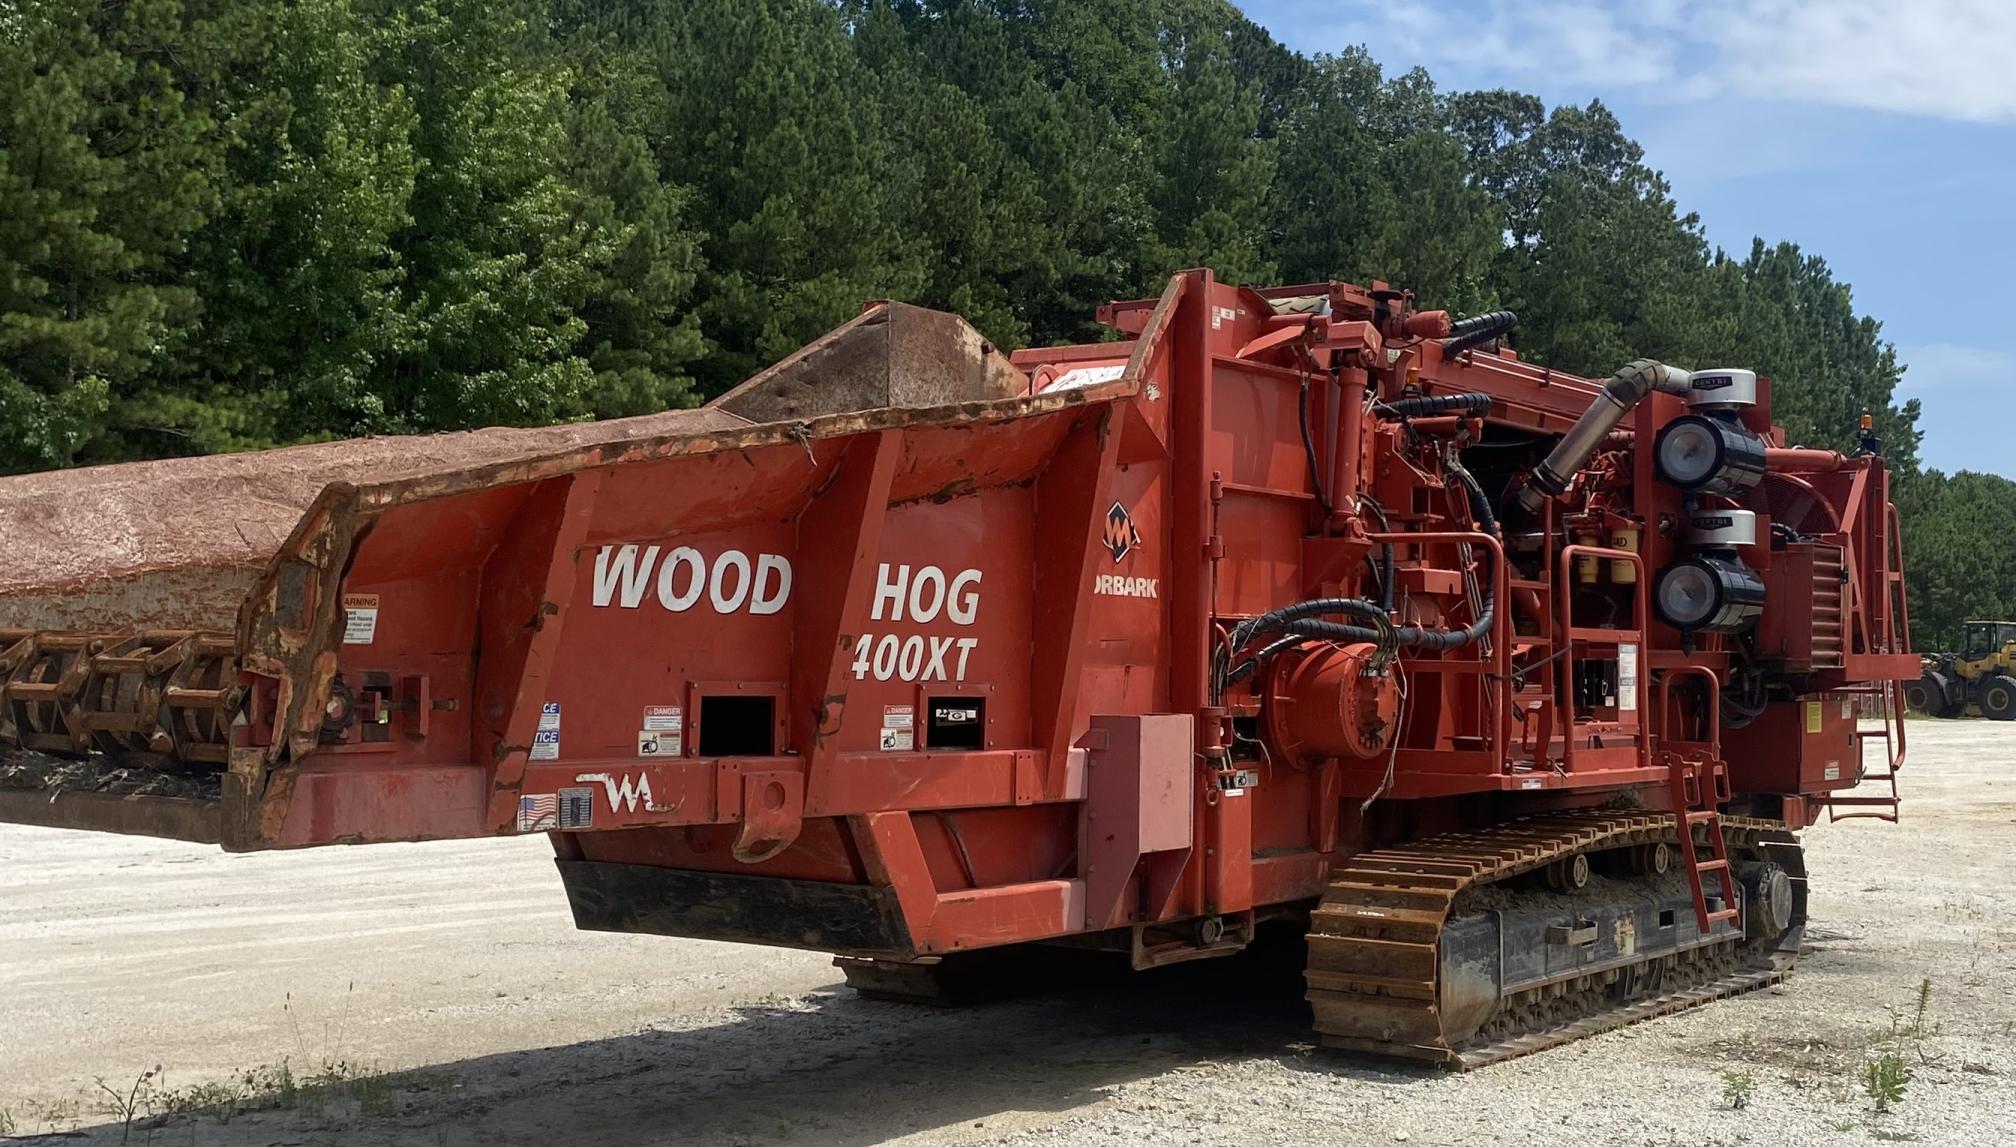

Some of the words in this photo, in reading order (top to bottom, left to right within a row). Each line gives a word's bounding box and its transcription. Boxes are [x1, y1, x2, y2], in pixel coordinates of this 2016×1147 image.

[593, 545, 792, 614] WOOD
[871, 563, 982, 625] HOG
[852, 634, 978, 681] 400XT
[653, 707, 681, 716] DANGER
